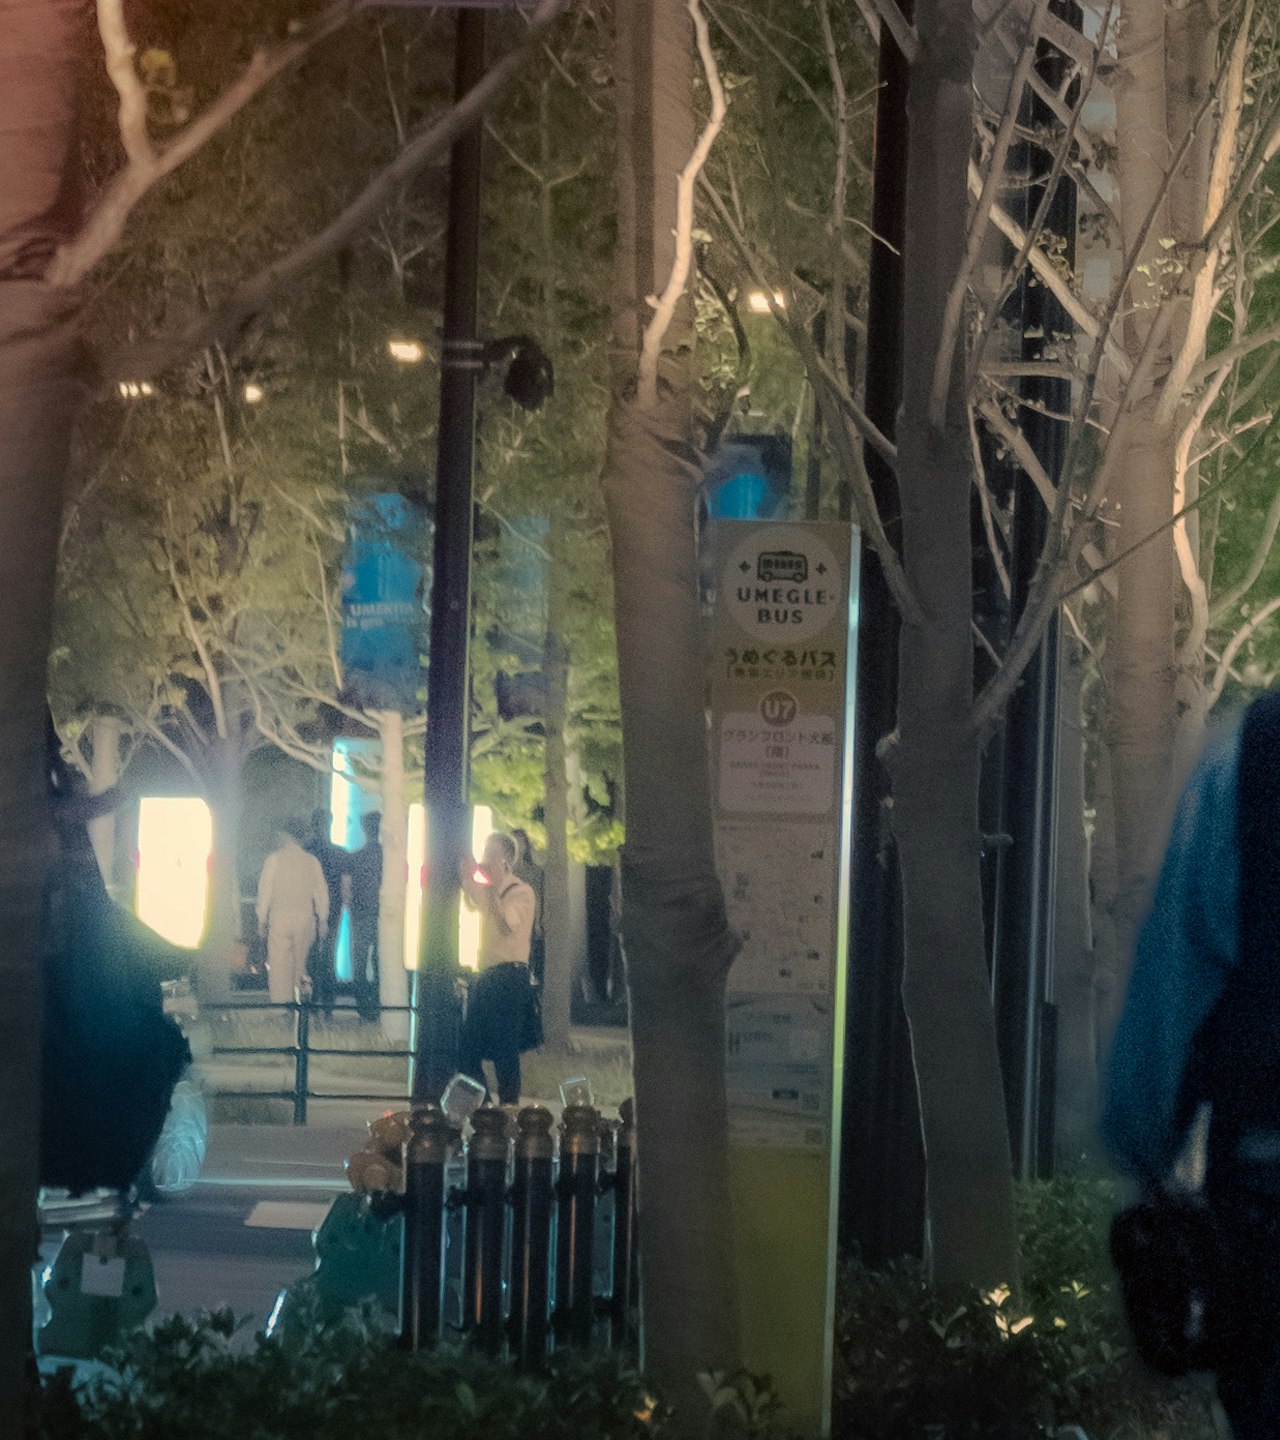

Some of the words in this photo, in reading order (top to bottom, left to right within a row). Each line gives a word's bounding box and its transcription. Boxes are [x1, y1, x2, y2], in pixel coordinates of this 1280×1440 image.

[737, 586, 827, 605] UMEGLE
[756, 608, 804, 625] BUS
[764, 700, 794, 720] U7
